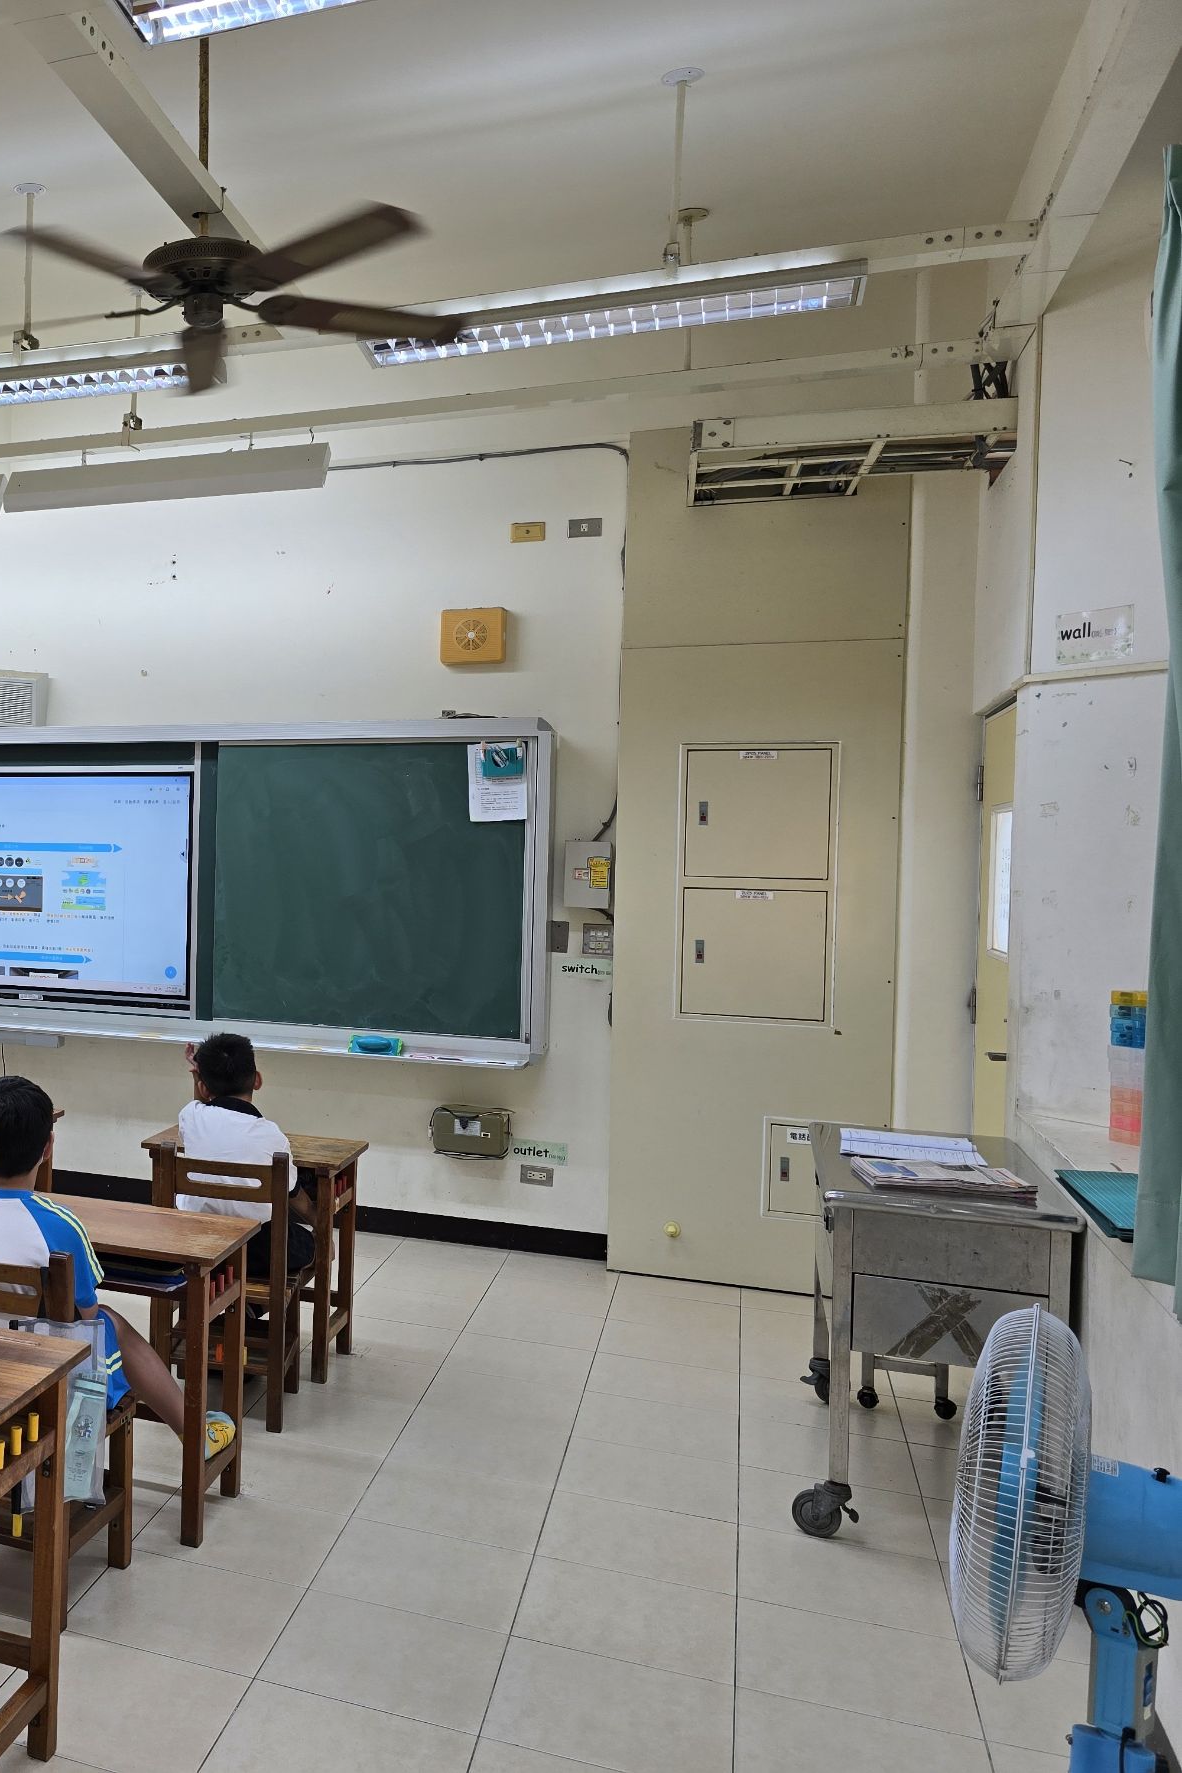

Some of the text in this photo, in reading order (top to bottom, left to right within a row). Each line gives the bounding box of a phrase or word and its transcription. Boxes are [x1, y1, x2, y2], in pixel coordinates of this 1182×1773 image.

[1060, 622, 1091, 641] wall
[561, 964, 598, 975] switch
[513, 1146, 549, 1158] outlet
